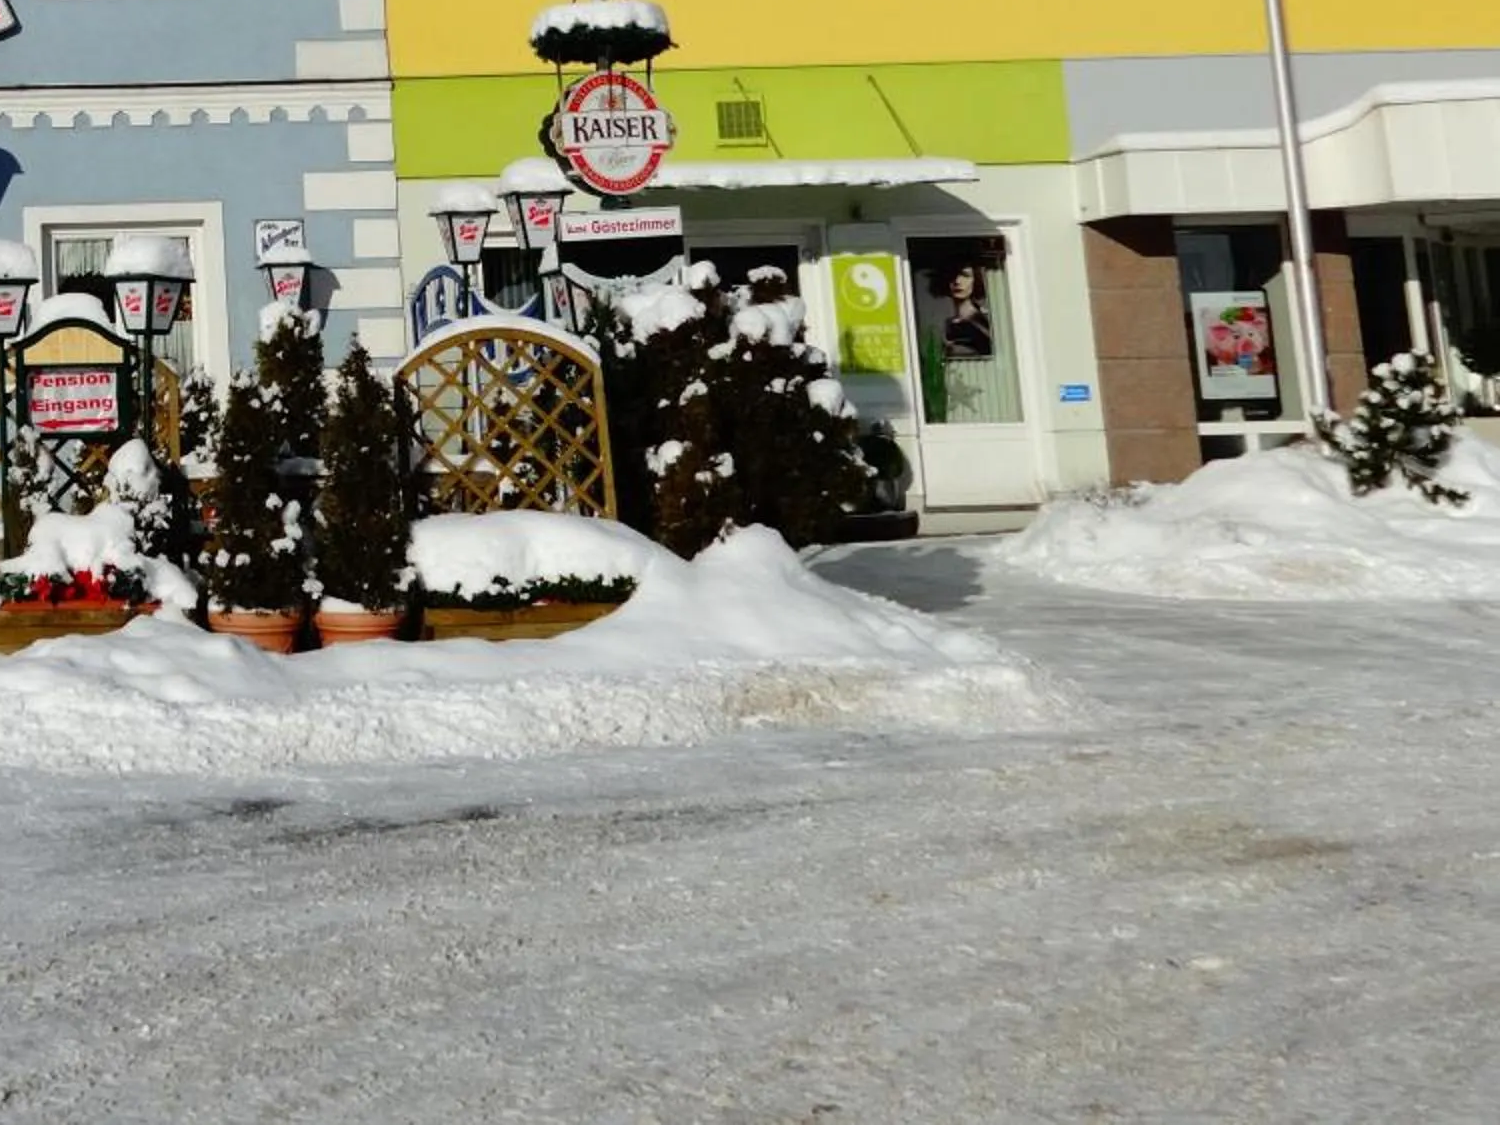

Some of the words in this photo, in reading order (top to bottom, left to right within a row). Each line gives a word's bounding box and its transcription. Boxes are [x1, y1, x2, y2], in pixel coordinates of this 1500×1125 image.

[572, 116, 658, 142] KAISER
[29, 369, 112, 389] Pension
[29, 396, 114, 414] Eingang
